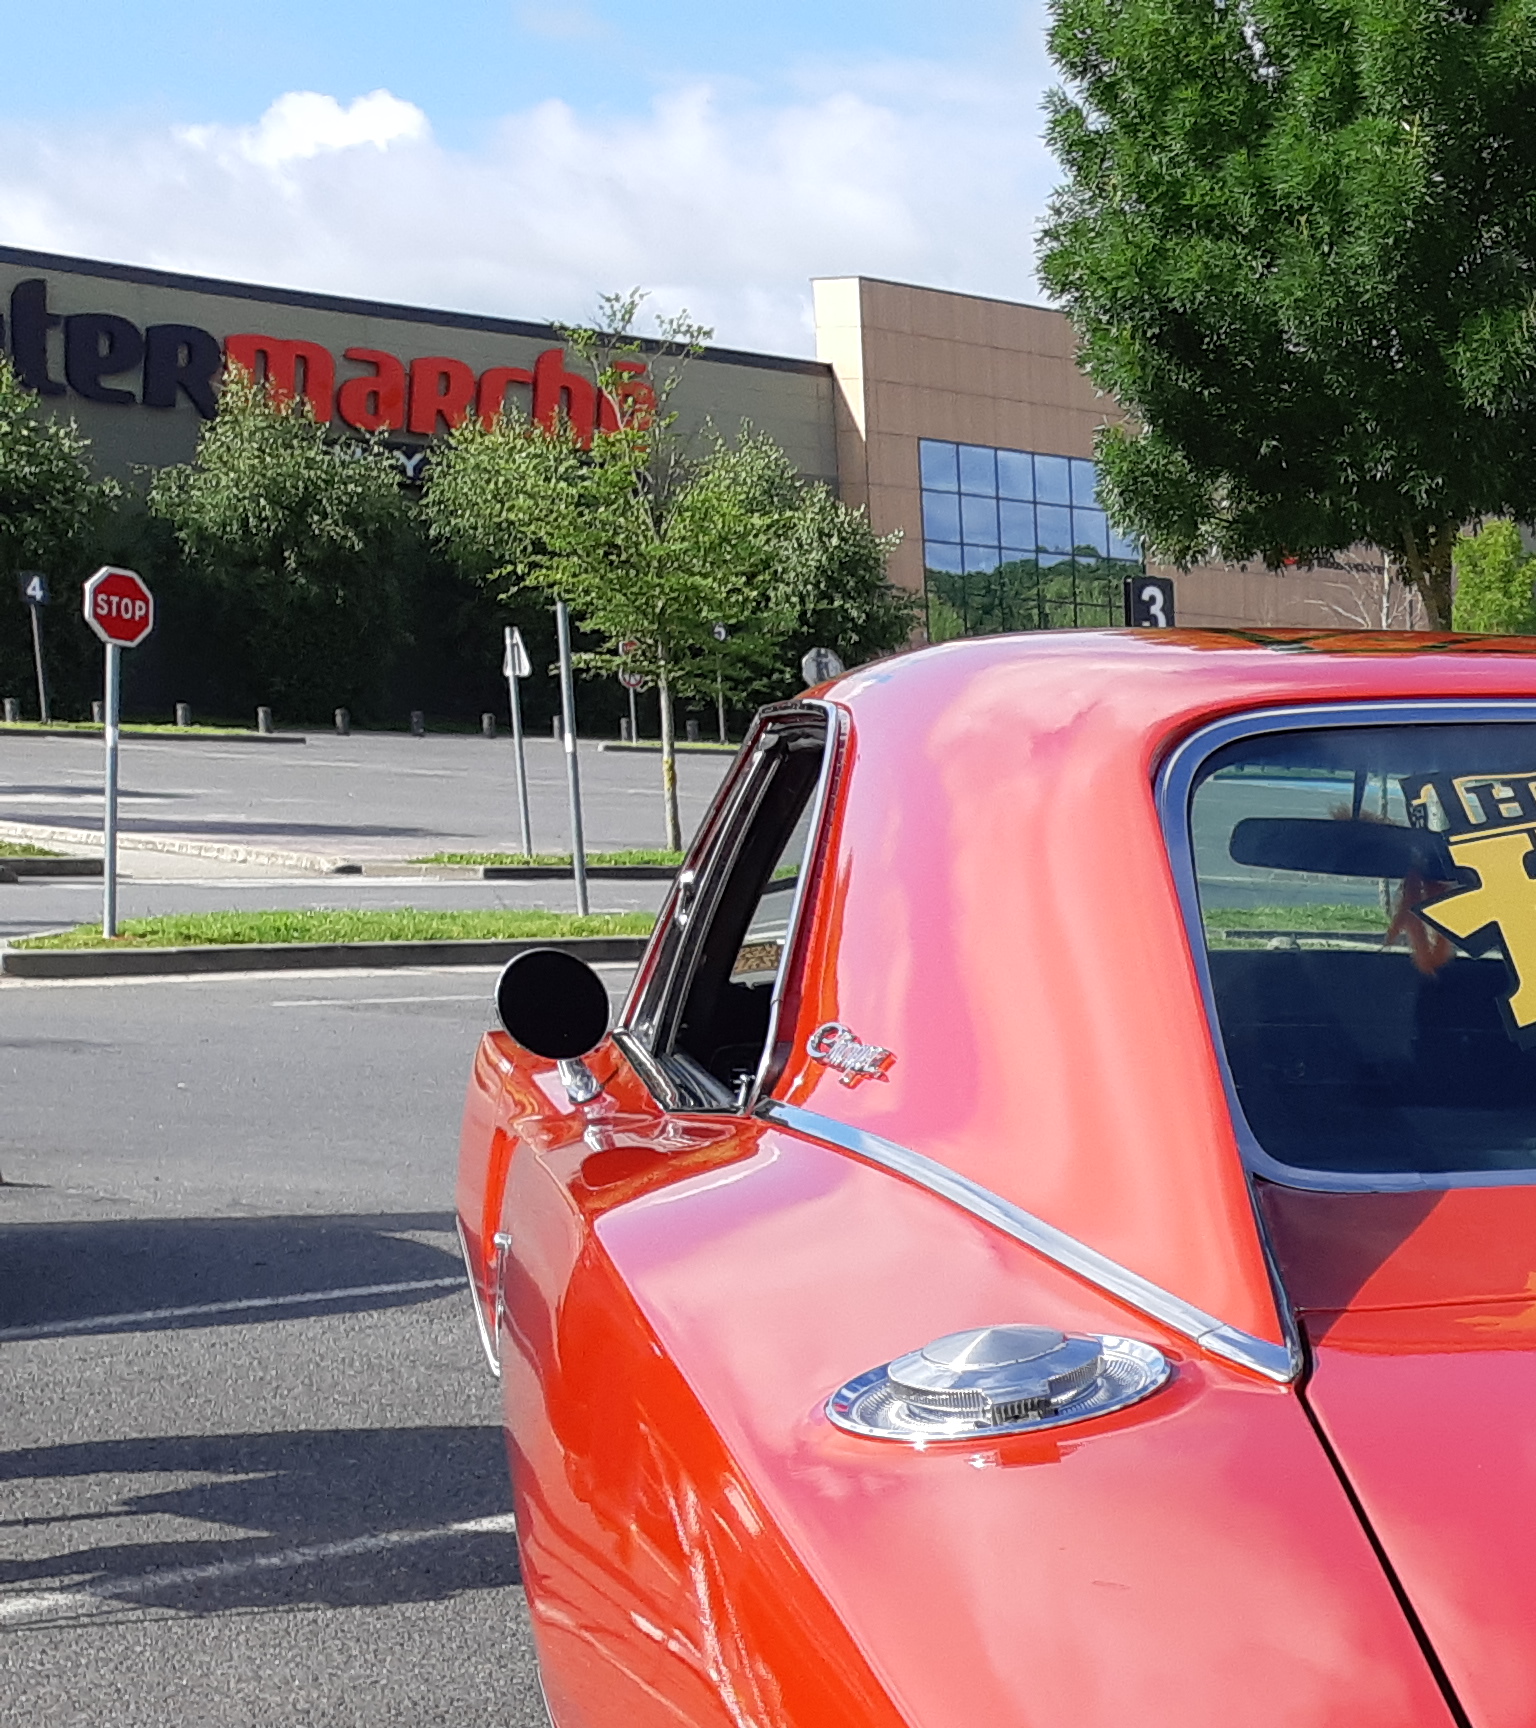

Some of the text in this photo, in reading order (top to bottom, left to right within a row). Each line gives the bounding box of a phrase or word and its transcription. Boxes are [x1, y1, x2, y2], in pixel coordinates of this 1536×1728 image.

[26, 575, 43, 601] 4
[96, 593, 147, 621] STOP
[1141, 586, 1167, 628] 3
